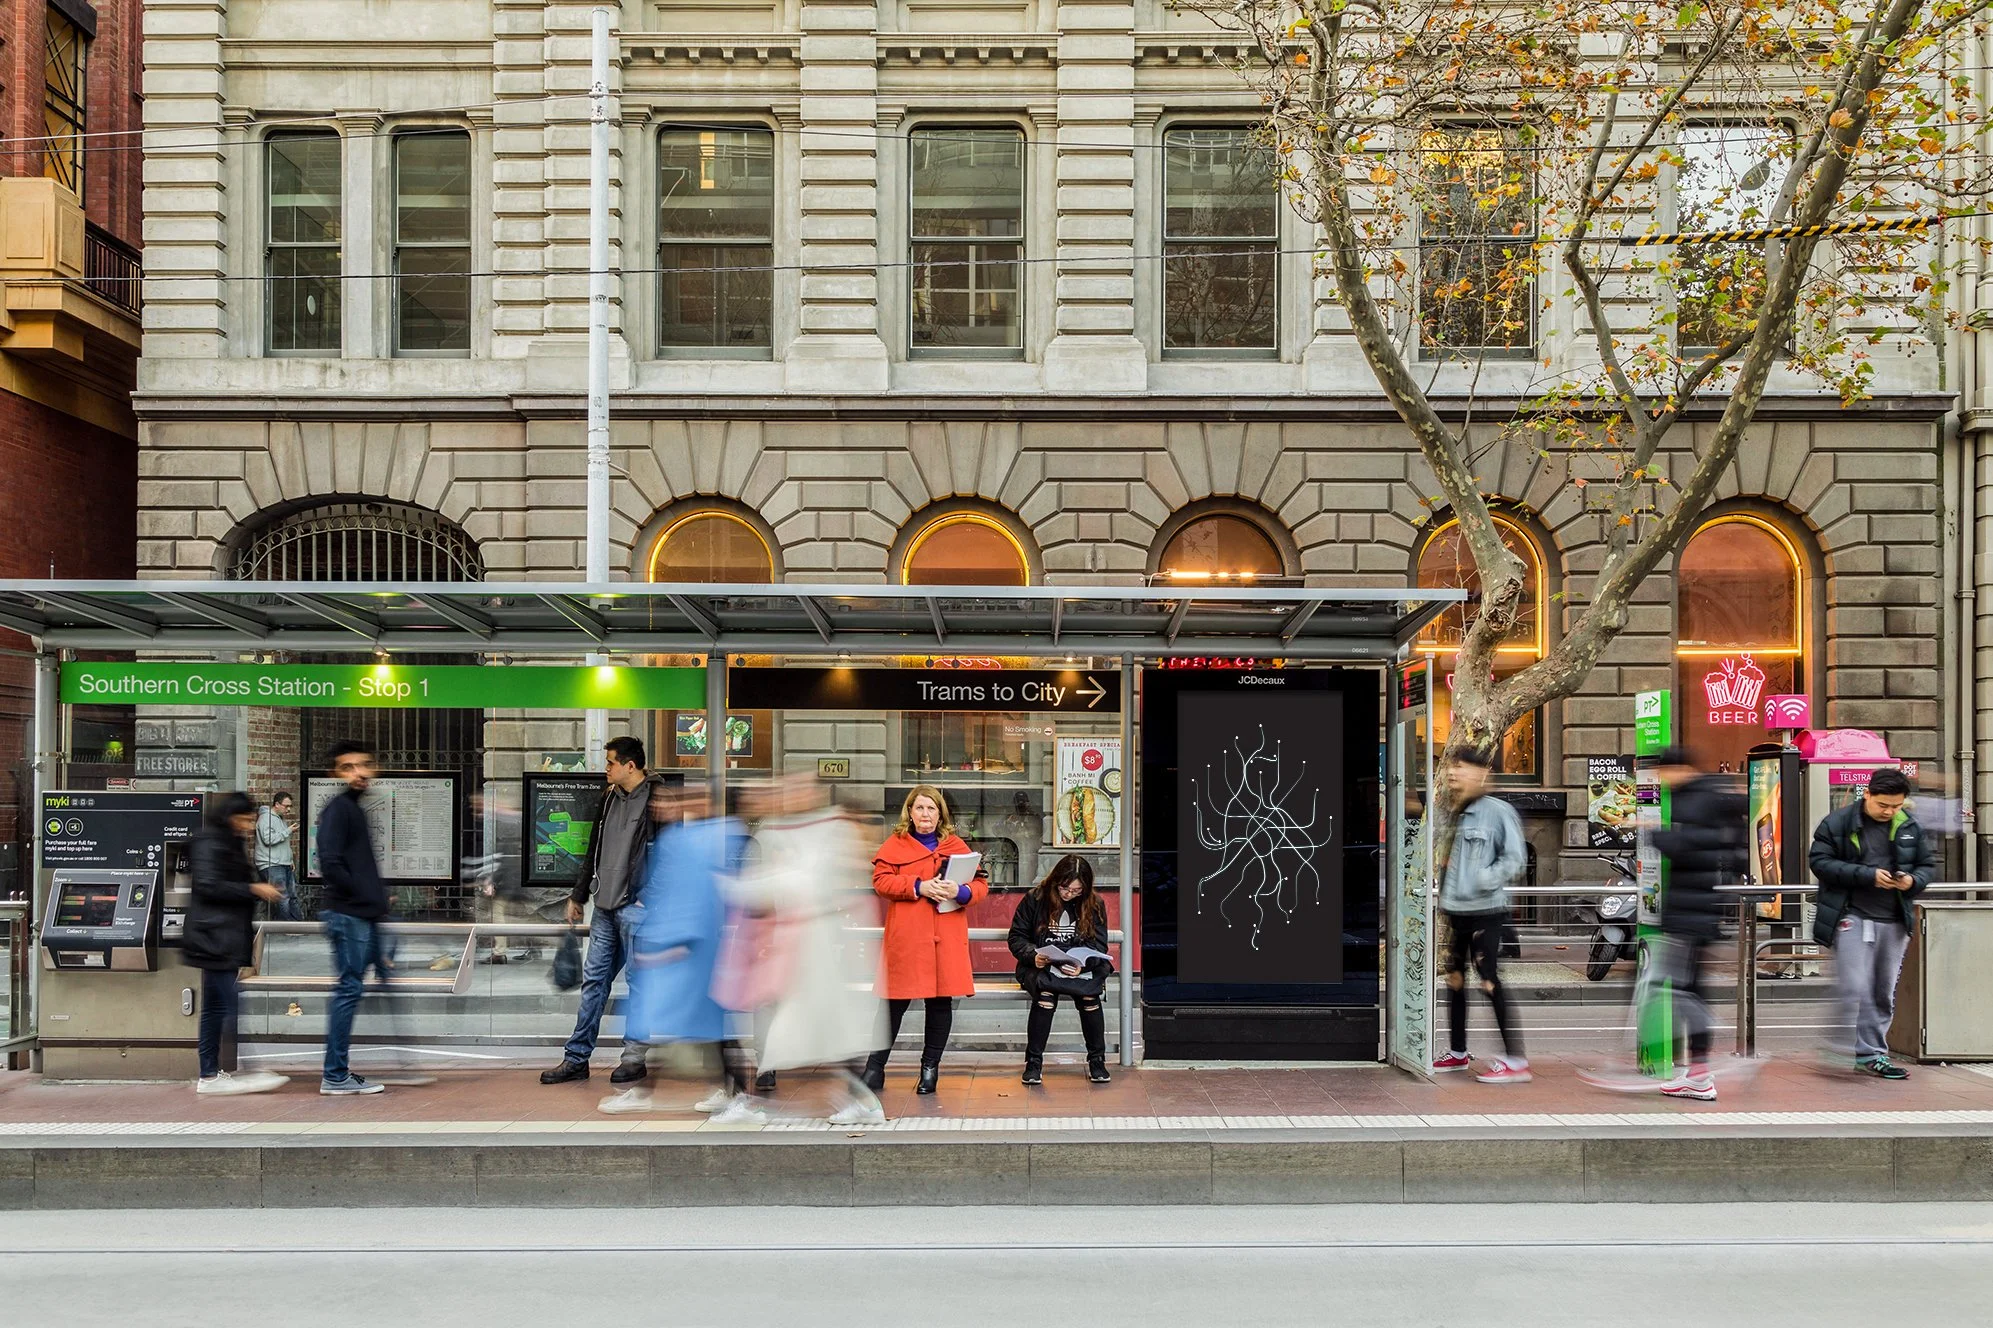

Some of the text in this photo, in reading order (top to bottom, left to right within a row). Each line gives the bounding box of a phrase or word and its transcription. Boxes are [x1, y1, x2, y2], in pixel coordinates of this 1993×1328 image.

[1238, 676, 1285, 685] JCDecaux
[79, 674, 179, 694] Southern
[186, 676, 250, 695] Cross
[257, 676, 335, 696] Station
[358, 677, 411, 701] Stop
[420, 679, 429, 697] 1
[916, 681, 1066, 707] Trams to City
[1643, 700, 1653, 713] PT
[1709, 711, 1758, 724] BEER
[1015, 725, 1042, 734] Smoking
[136, 757, 164, 771] FREE
[1589, 758, 1617, 766] BACON
[823, 763, 843, 773] 670
[1596, 773, 1627, 781] COFFEE
[1839, 773, 1872, 782] TELSTRA
[536, 782, 564, 790] Melbourne's
[45, 796, 70, 809] myki
[185, 799, 195, 807] PT
